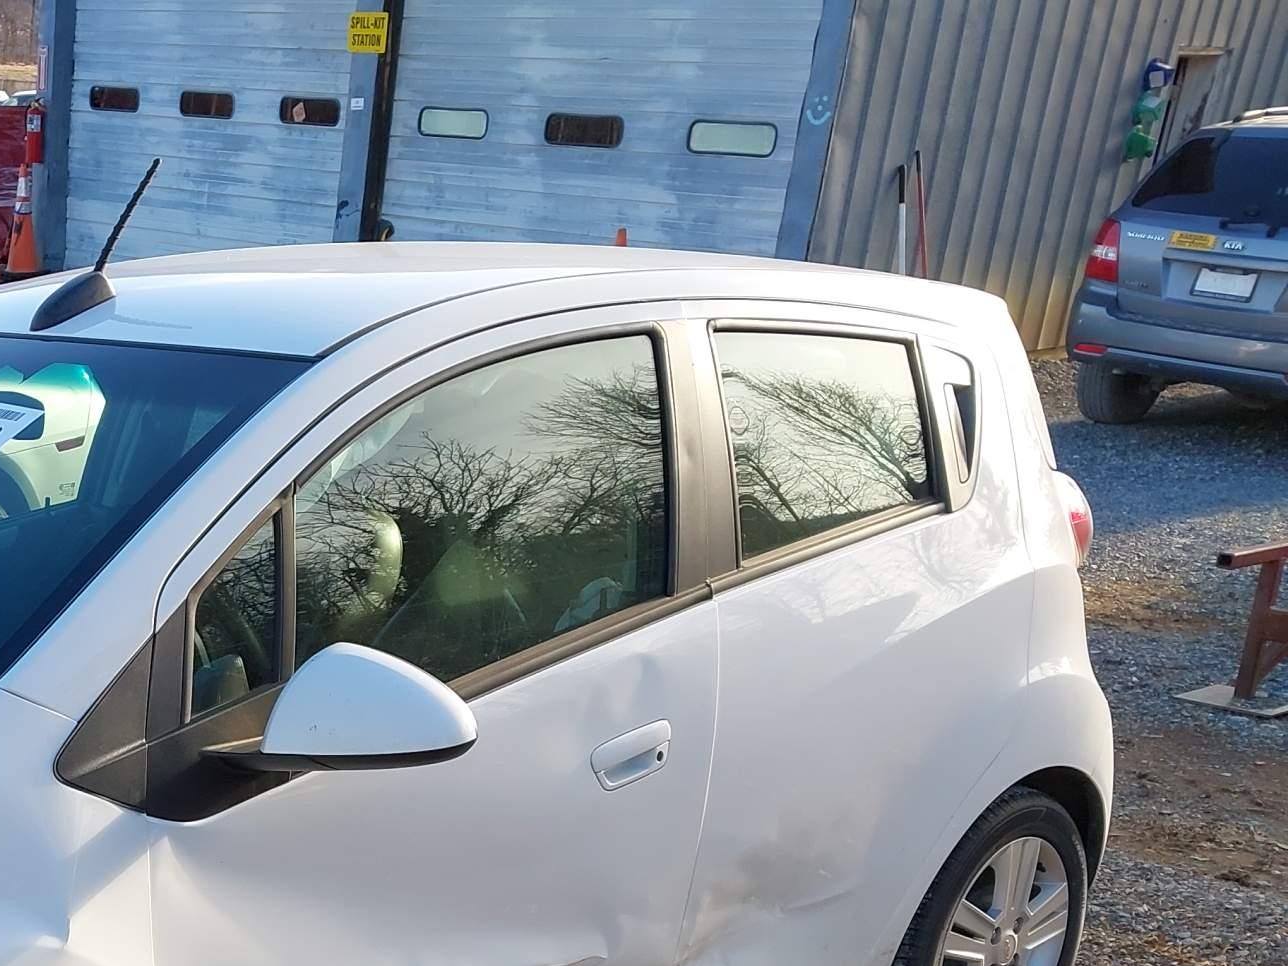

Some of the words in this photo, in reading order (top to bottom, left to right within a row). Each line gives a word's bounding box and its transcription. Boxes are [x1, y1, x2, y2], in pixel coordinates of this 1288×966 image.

[351, 16, 385, 29] SPILL-KIT
[352, 33, 382, 46] STATION
[1224, 240, 1242, 250] KIA
